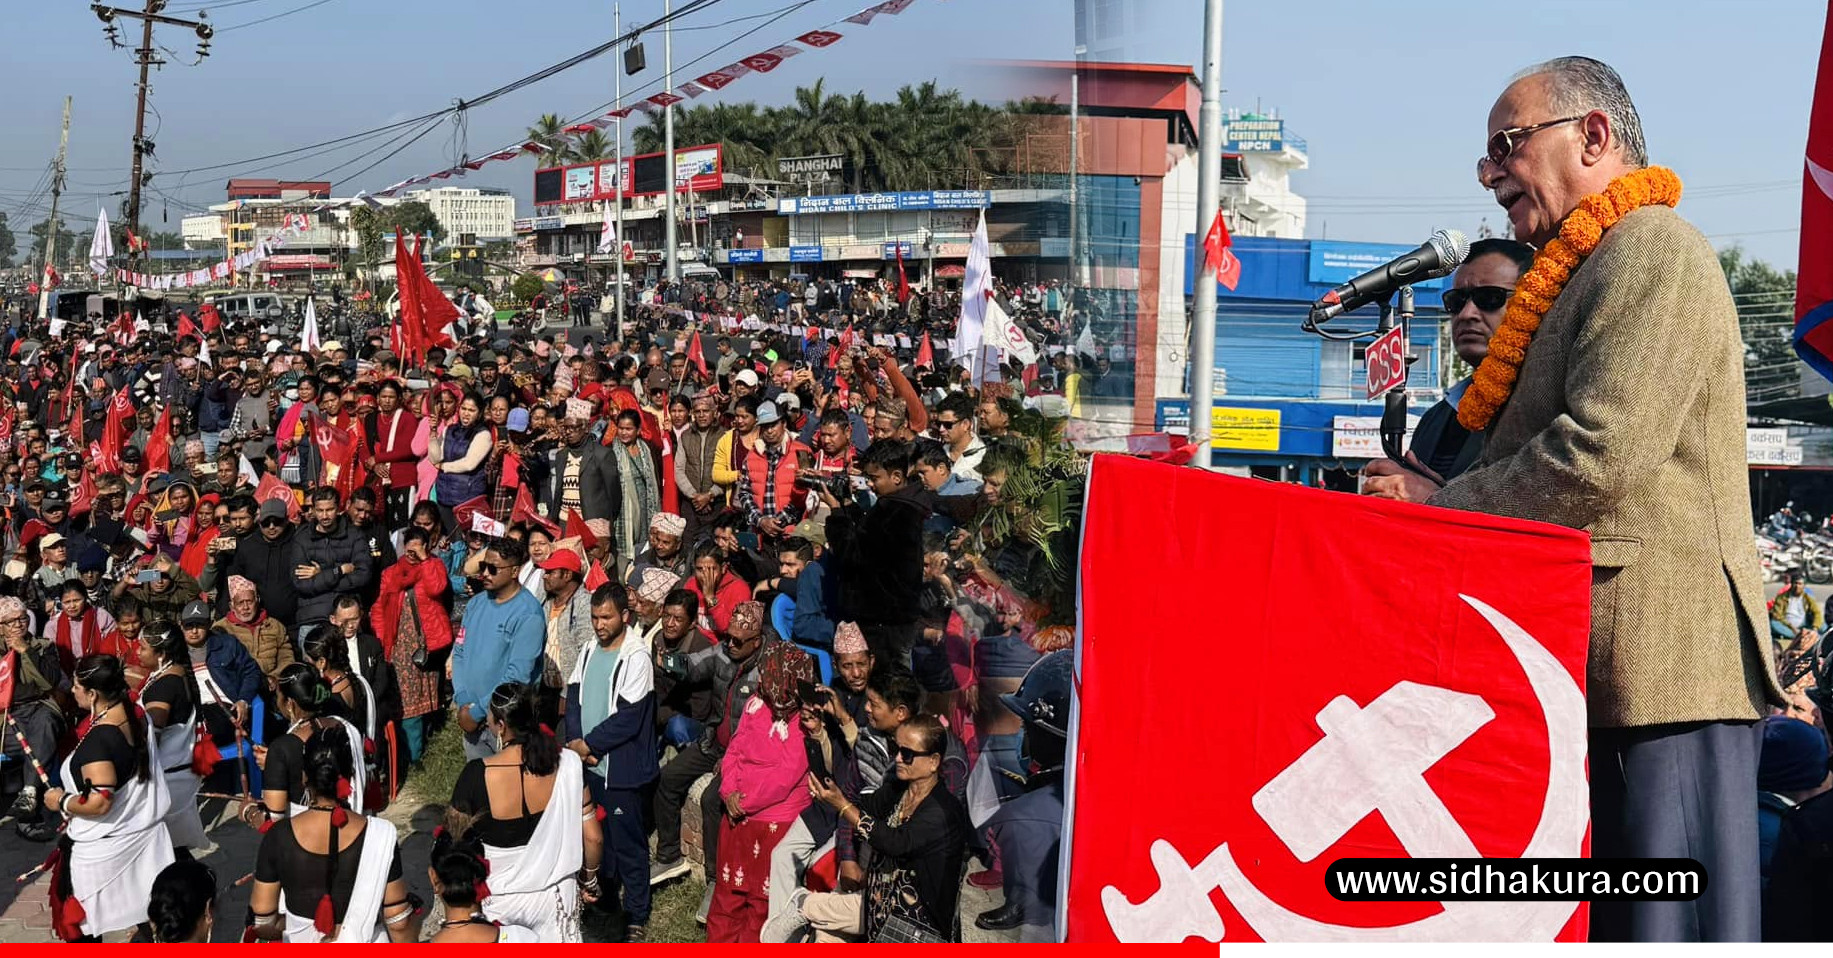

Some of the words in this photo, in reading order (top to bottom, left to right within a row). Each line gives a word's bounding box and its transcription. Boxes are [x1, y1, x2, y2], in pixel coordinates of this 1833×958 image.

[1238, 141, 1271, 150] NPCN
[779, 157, 843, 173] SHANGHAI
[790, 171, 830, 183] PLAZA
[799, 205, 827, 214] NIDAN
[828, 204, 863, 212] CHILD'S
[867, 203, 897, 211] CLINIC
[1368, 335, 1402, 393] CSS
